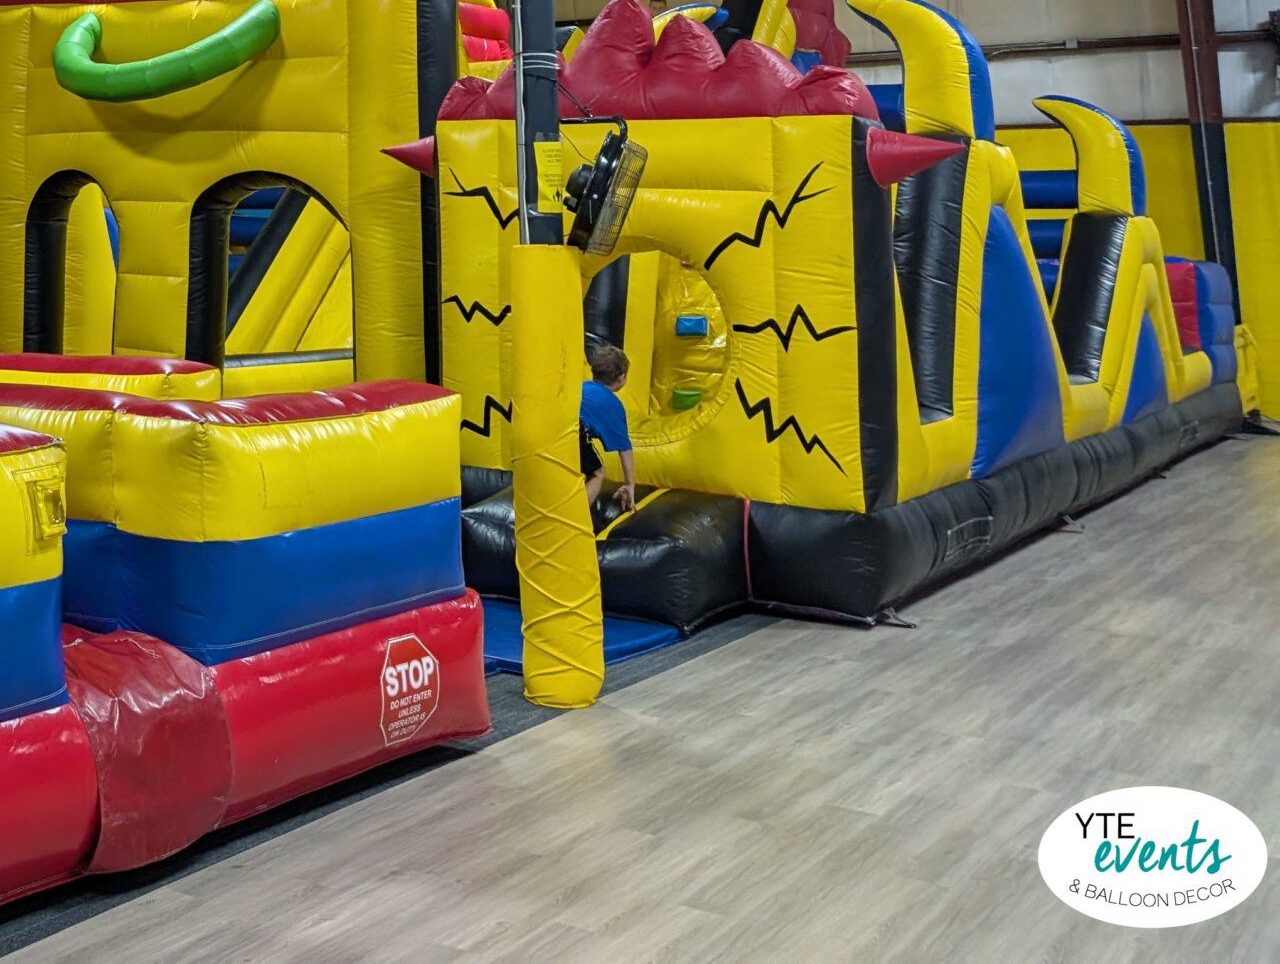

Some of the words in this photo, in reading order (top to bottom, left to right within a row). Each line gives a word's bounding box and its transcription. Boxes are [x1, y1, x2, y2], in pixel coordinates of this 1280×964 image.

[385, 655, 434, 698] STOP
[390, 700, 399, 710] DO
[400, 696, 412, 706] NOT
[413, 689, 432, 703] ENTER
[398, 704, 421, 718] UNLESS
[388, 714, 419, 731] OPERATOR
[420, 712, 426, 720] IS
[400, 724, 417, 736] DUTY
